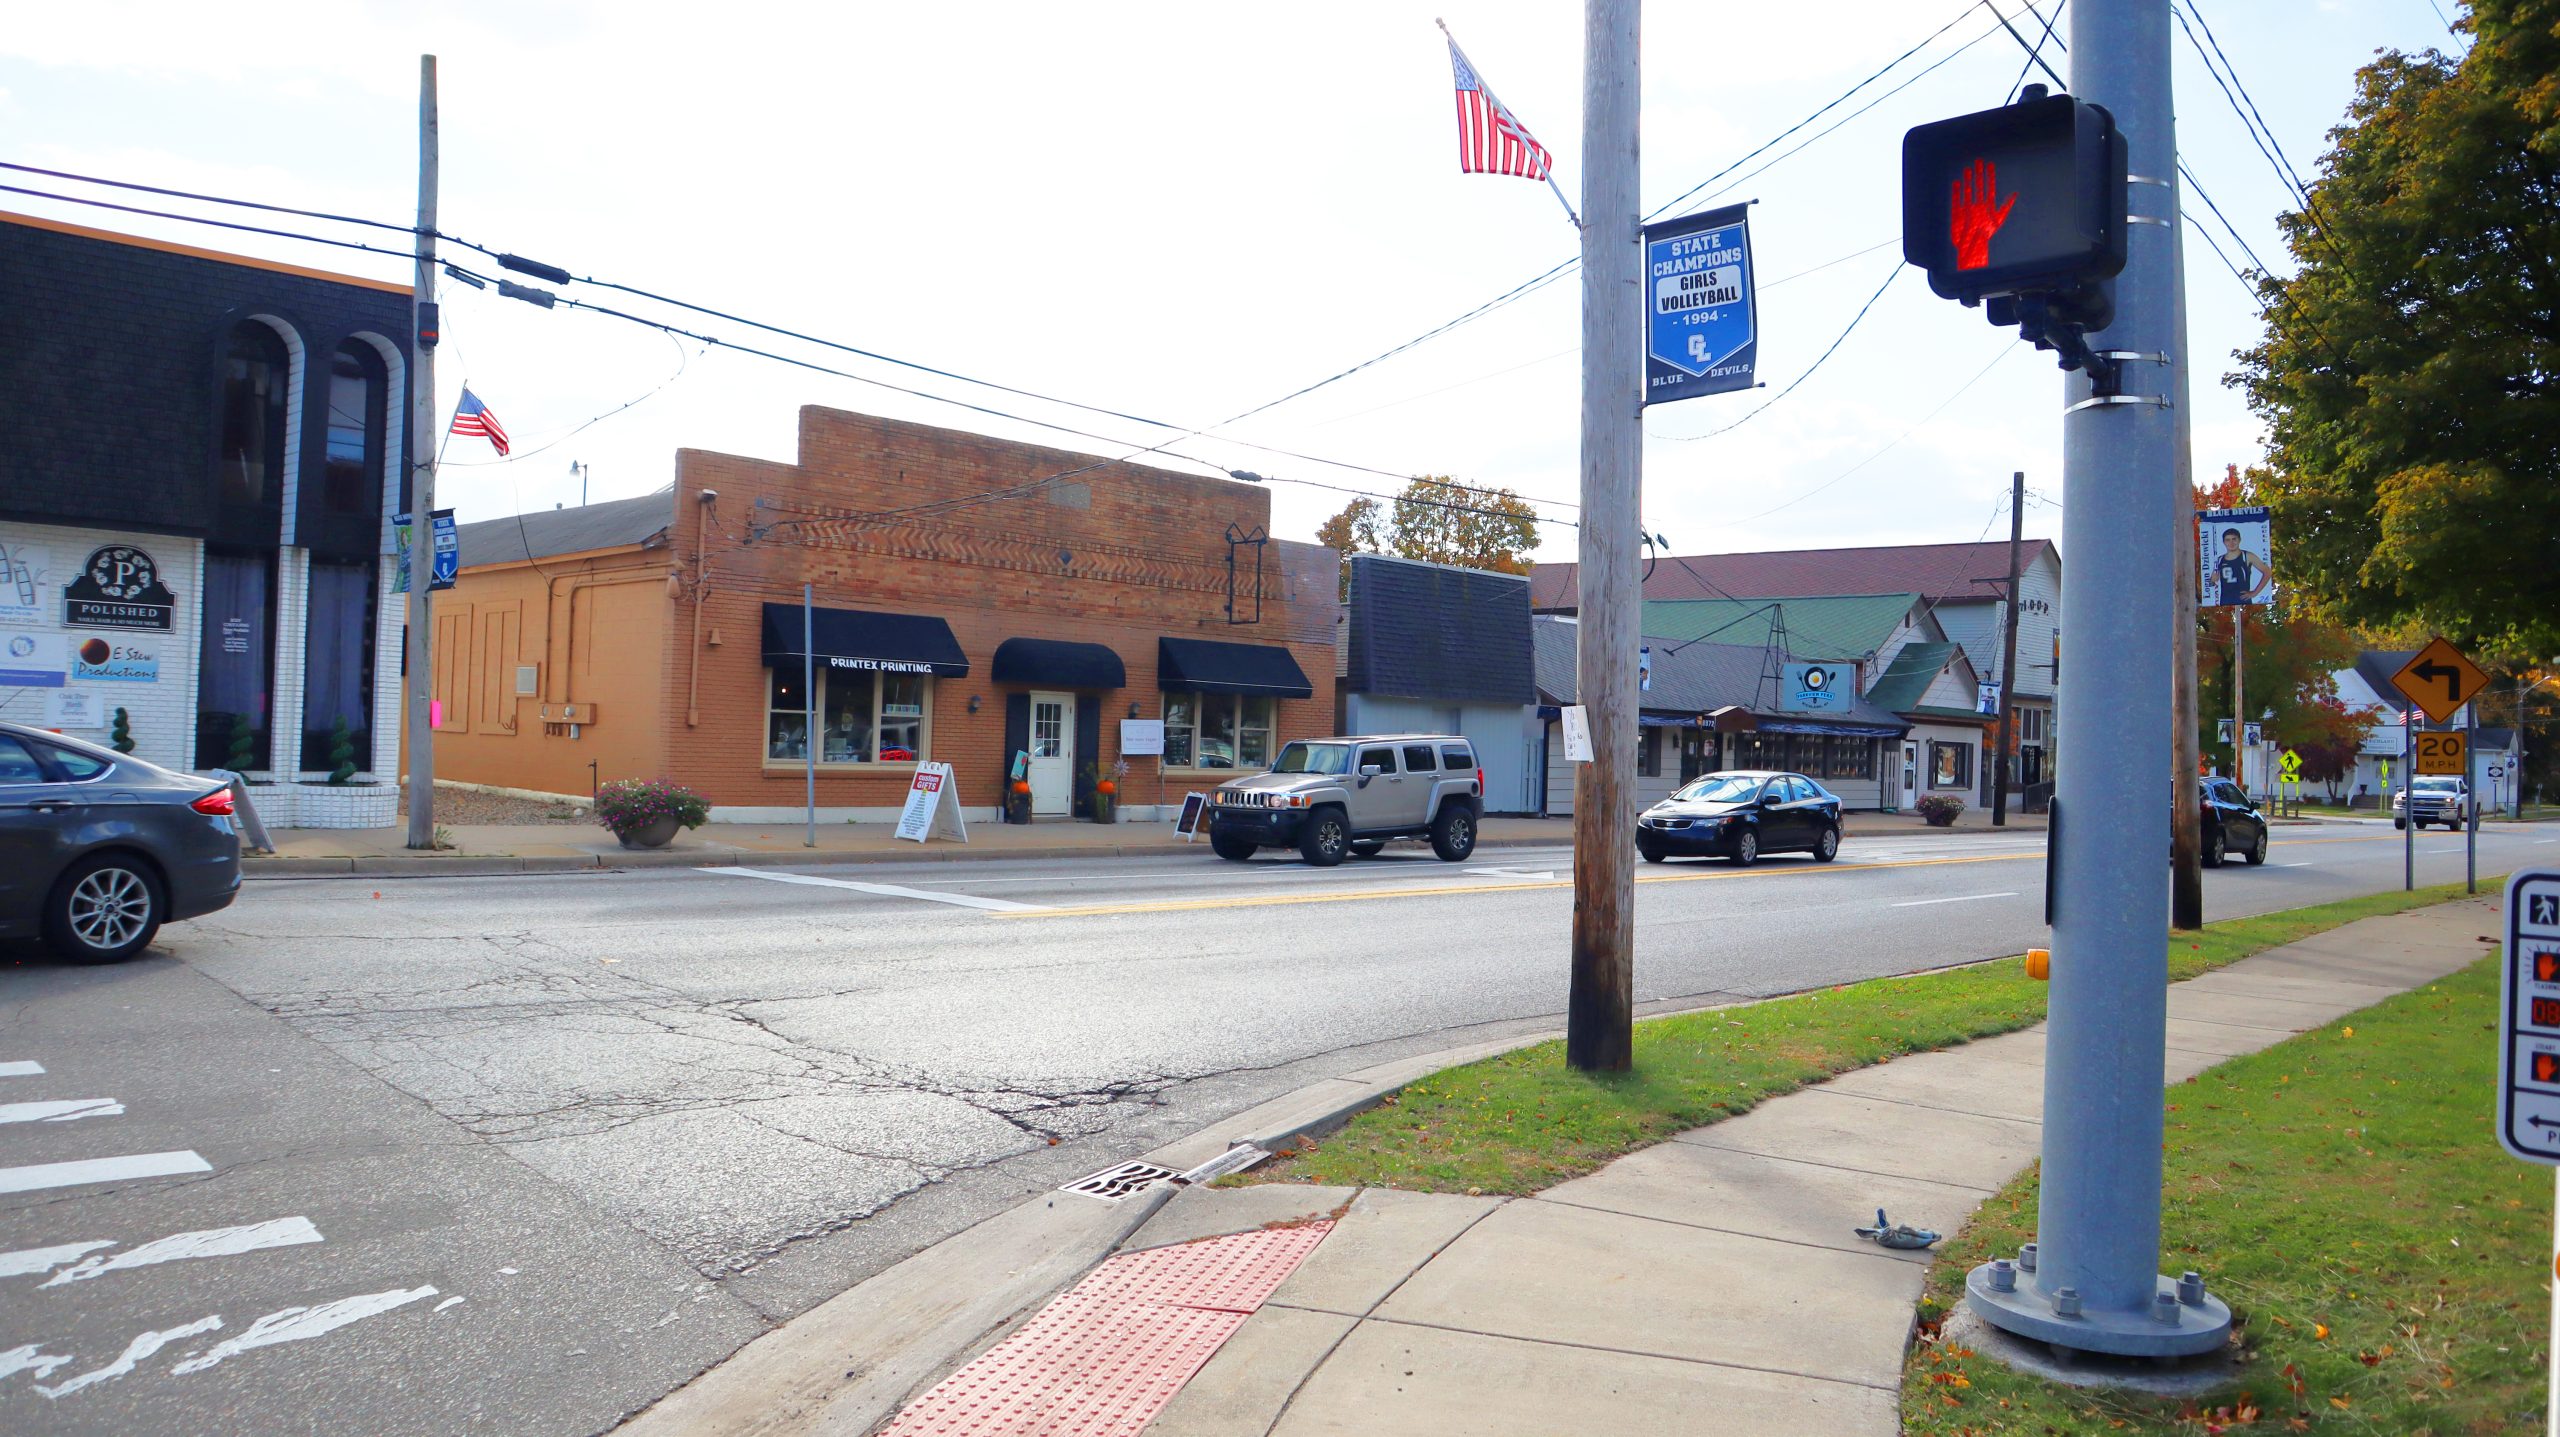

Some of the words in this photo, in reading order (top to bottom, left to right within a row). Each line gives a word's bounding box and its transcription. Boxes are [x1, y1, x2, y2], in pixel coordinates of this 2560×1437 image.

[1671, 233, 1722, 257] STATE
[1653, 247, 1742, 277] CHAMPIONS
[1680, 271, 1718, 291] GIRLS
[1661, 286, 1738, 312] VOLLEYBALL
[1682, 310, 1719, 326] 1994
[1652, 374, 1684, 387] BLUE
[1710, 364, 1749, 378] DEVILS
[2206, 508, 2230, 517] BLUE
[2231, 506, 2264, 516] DEVILS
[113, 561, 135, 585] P
[81, 604, 158, 618] POLISHED
[113, 646, 122, 660] E
[77, 661, 156, 679] Productions
[830, 657, 878, 670] PRINTEX
[880, 661, 933, 673] PRINTING
[2422, 737, 2460, 757] 20
[916, 781, 937, 790] GIFTS
